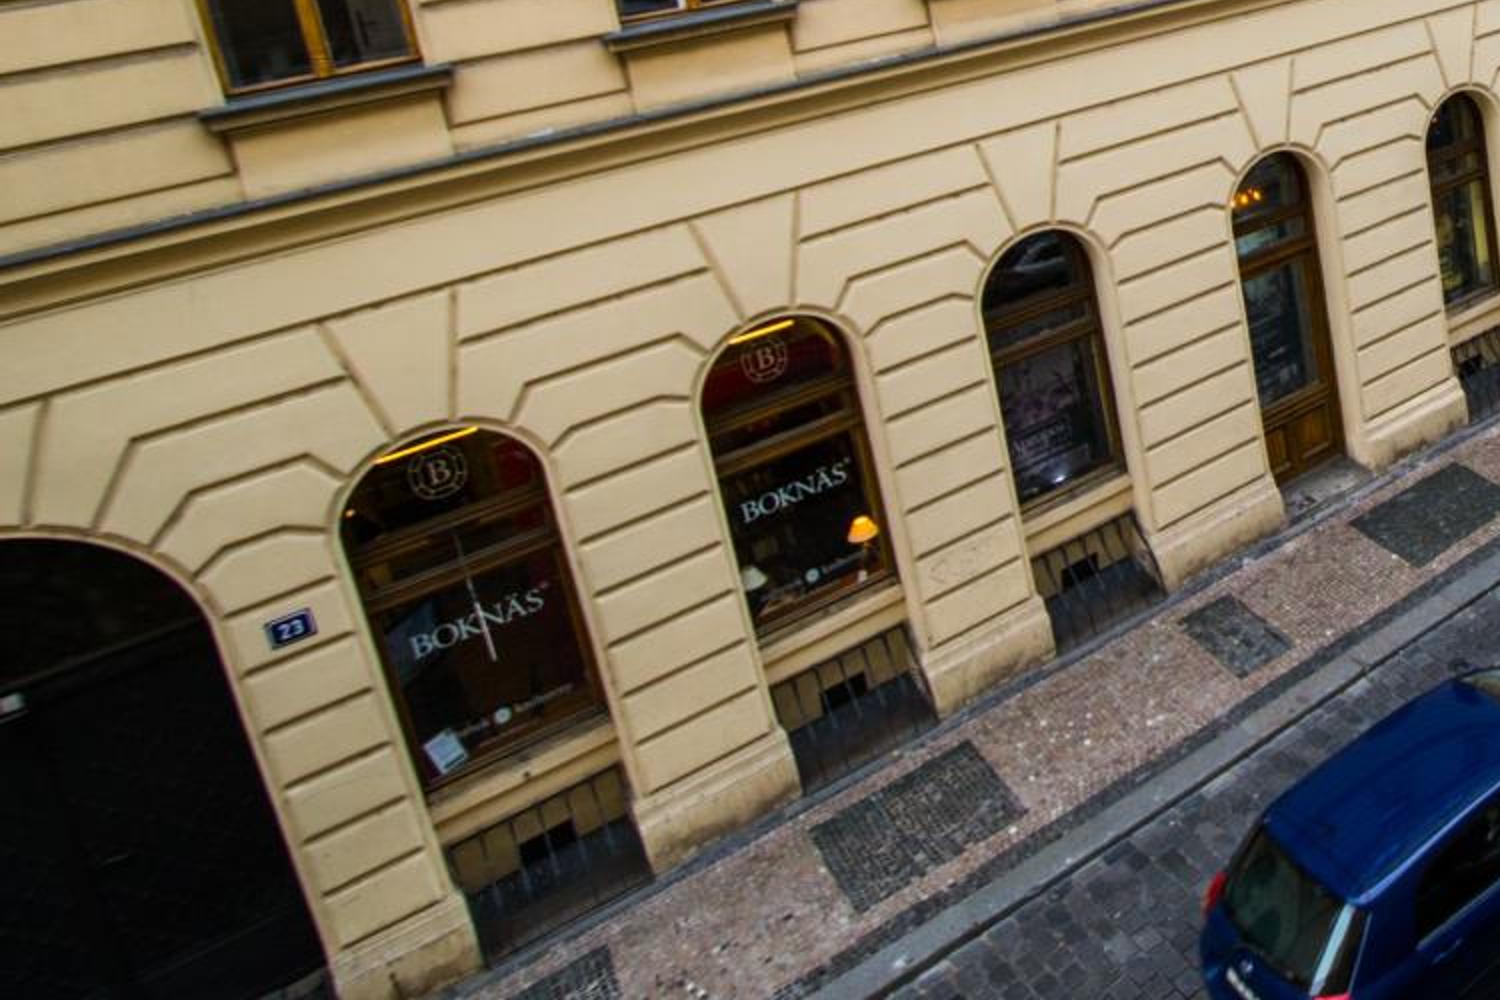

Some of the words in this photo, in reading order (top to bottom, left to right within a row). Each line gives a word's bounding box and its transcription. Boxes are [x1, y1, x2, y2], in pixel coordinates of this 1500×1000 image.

[427, 458, 451, 486] B
[741, 463, 849, 523] BOKNÄS
[277, 618, 305, 640] 23
[410, 588, 545, 659] BOKNÄS
